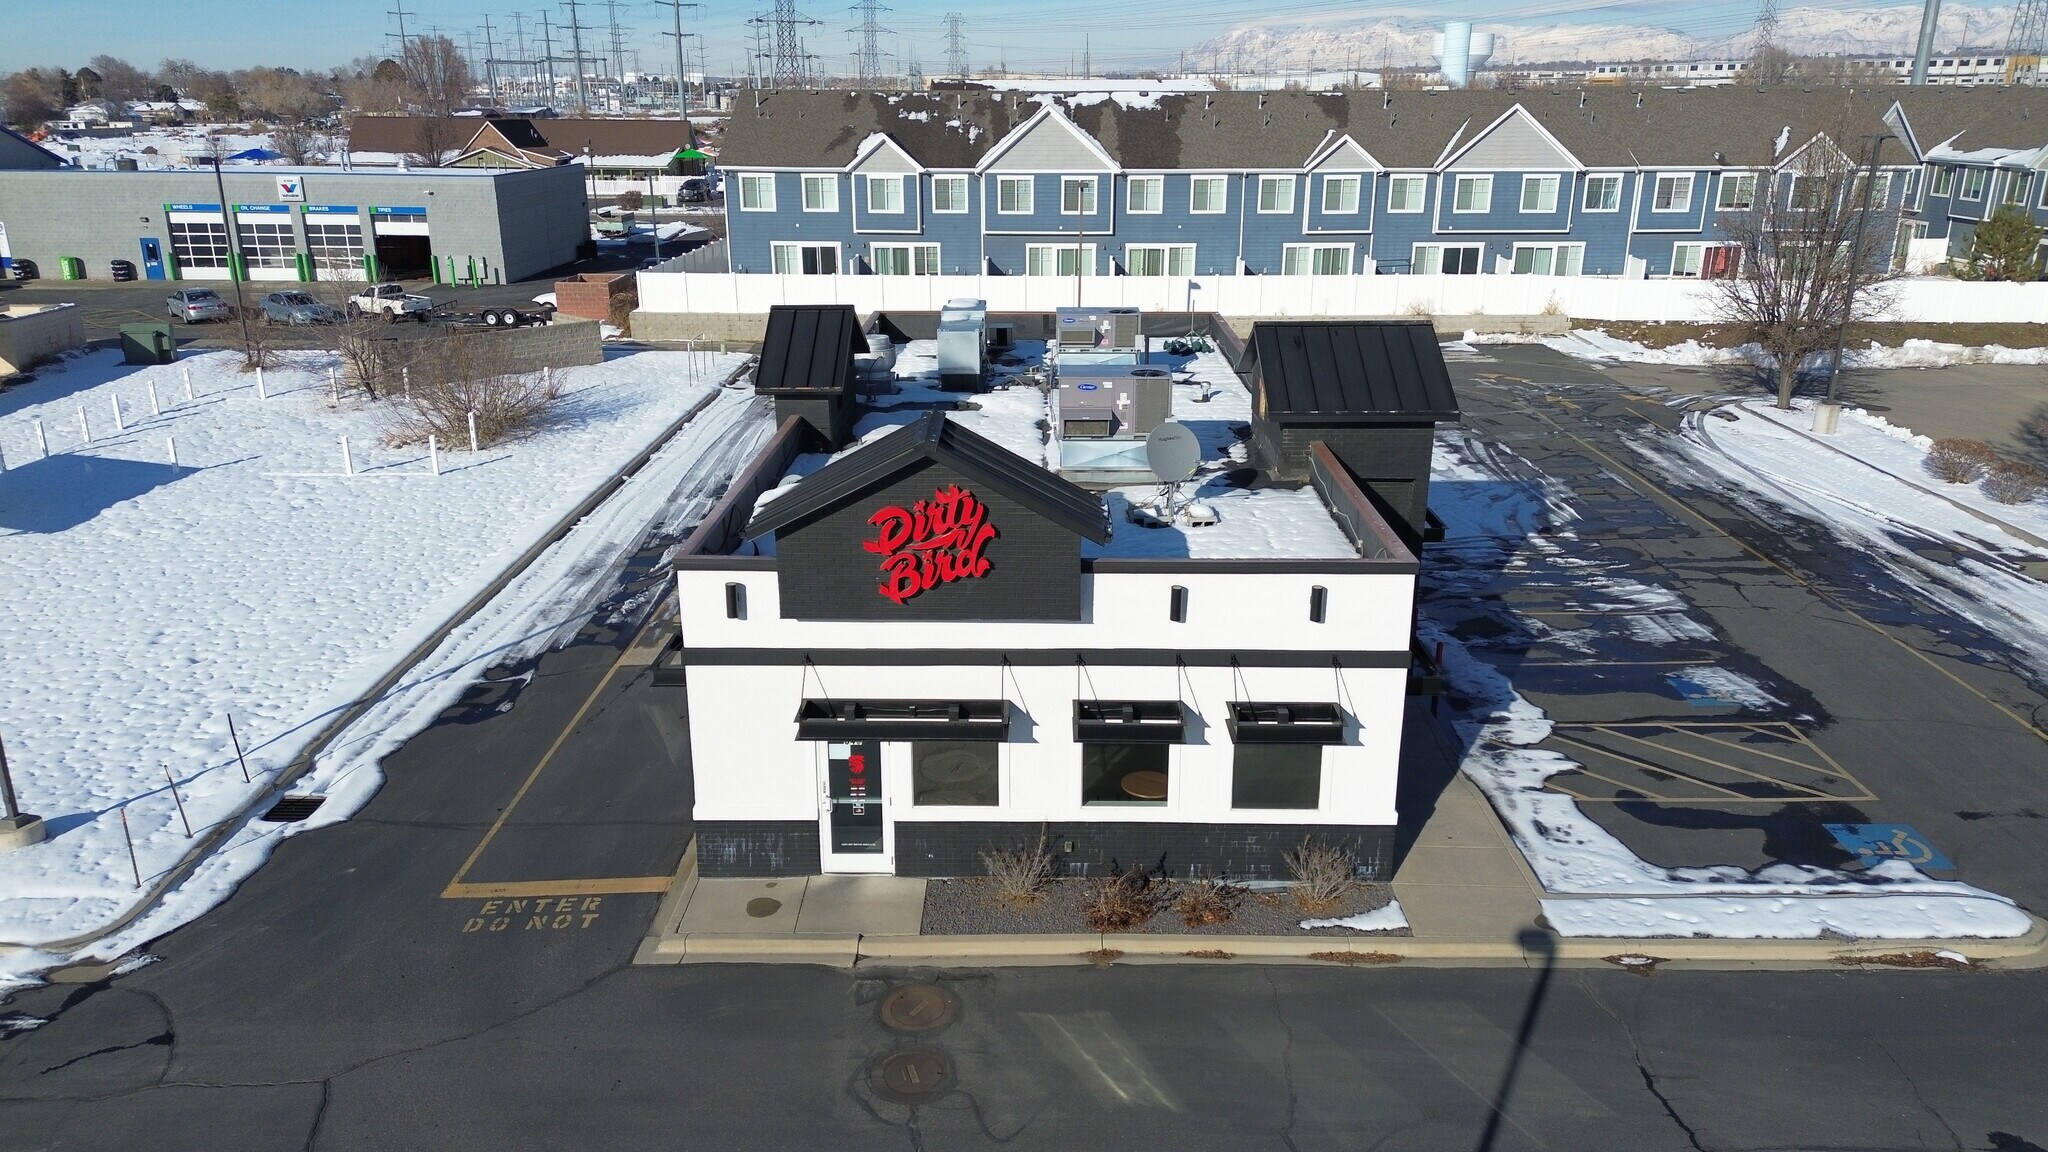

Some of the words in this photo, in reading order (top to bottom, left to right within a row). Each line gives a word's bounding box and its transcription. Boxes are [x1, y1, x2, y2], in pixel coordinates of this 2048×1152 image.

[862, 484, 985, 556] Dirty
[878, 522, 996, 605] Bird
[461, 915, 510, 933] DO
[525, 913, 600, 931] NOT
[480, 897, 602, 915] ENTER
